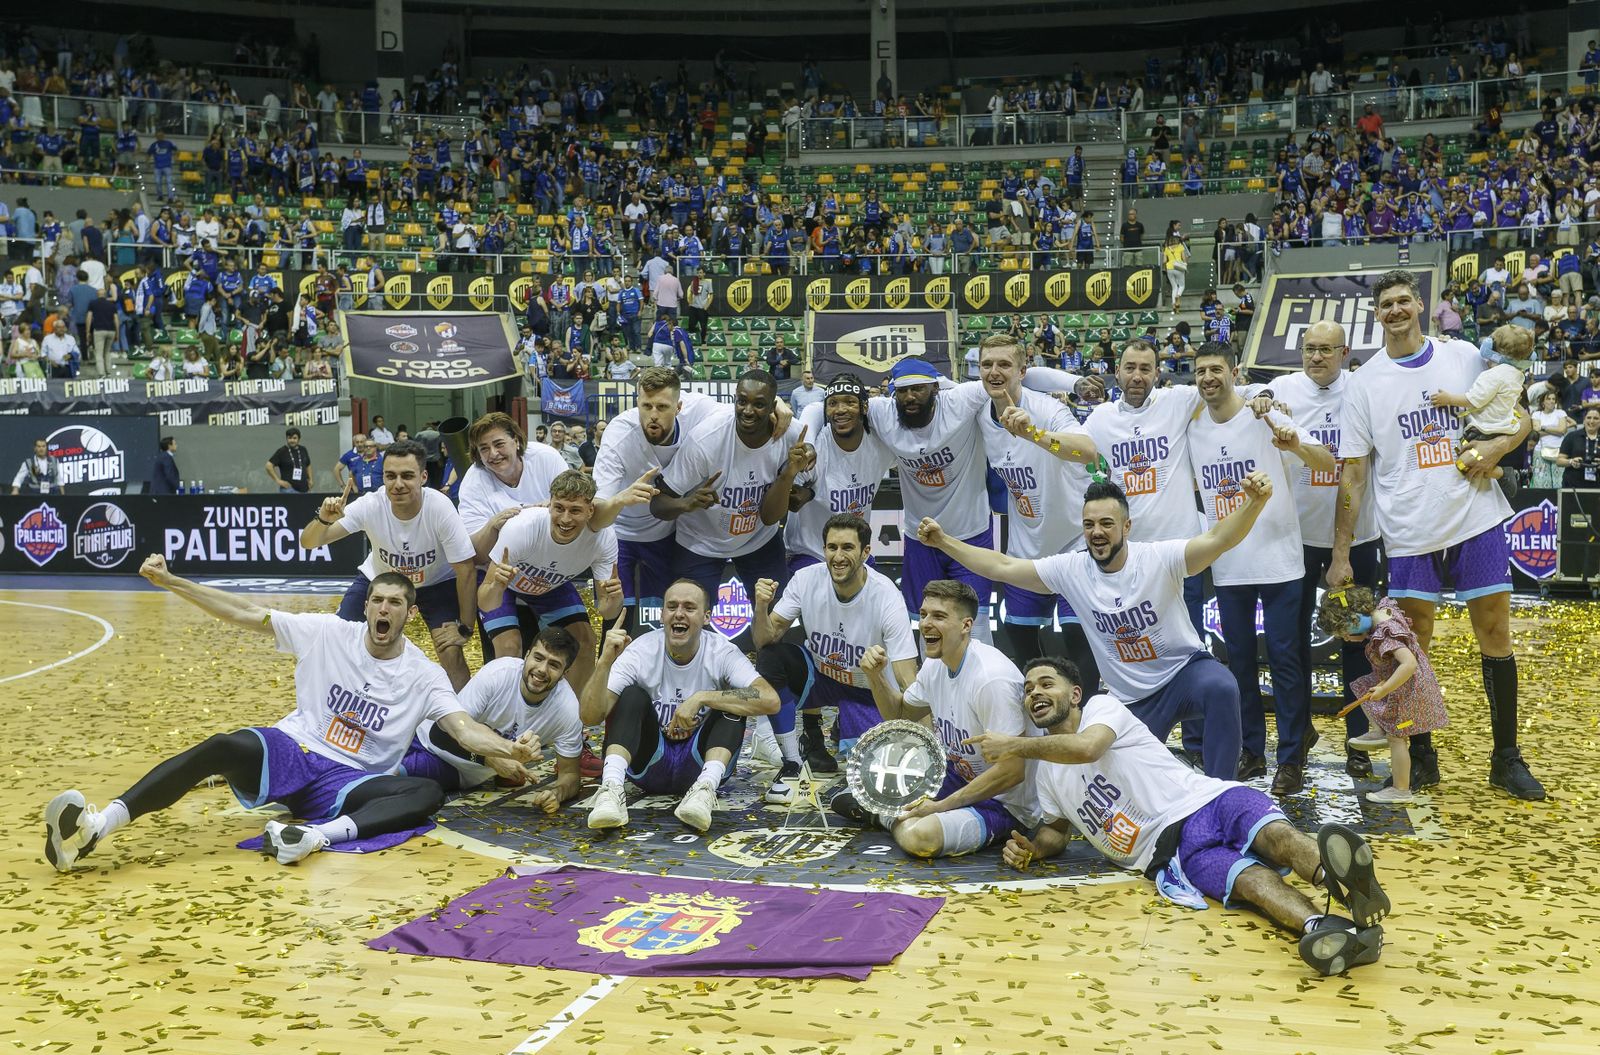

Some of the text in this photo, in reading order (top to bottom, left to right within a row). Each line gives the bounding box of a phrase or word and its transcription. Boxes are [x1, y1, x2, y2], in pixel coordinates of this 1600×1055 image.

[381, 31, 398, 50] D
[877, 40, 891, 59] E
[390, 282, 406, 303] 100
[432, 283, 448, 304] 100
[732, 286, 747, 306] 100
[772, 286, 787, 305] 100
[970, 282, 985, 303] 100
[1050, 280, 1065, 300] 100
[1091, 279, 1106, 299] 100
[1132, 278, 1147, 298] 100
[854, 335, 907, 362] 100
[376, 366, 490, 379] O NADA
[388, 359, 472, 369] TODO
[285, 406, 339, 426] FINALFOU
[1397, 405, 1461, 440] SOMOS
[1111, 436, 1169, 468] SOMOS
[1420, 441, 1451, 465] ACB
[1126, 471, 1153, 493] ACB
[830, 483, 876, 513] SOMOS
[203, 506, 288, 528] ZUNDER
[732, 514, 757, 533] ACB
[18, 528, 63, 544] PALENCIA
[1504, 532, 1557, 550] PALENC
[379, 547, 436, 569] SOMOS
[711, 603, 753, 617] ALENCIA
[1091, 600, 1159, 635] SOMOS
[810, 631, 866, 668] SOMOS
[1120, 641, 1153, 661] ACB
[326, 683, 390, 732] SOMOS
[862, 845, 892, 856] 2
